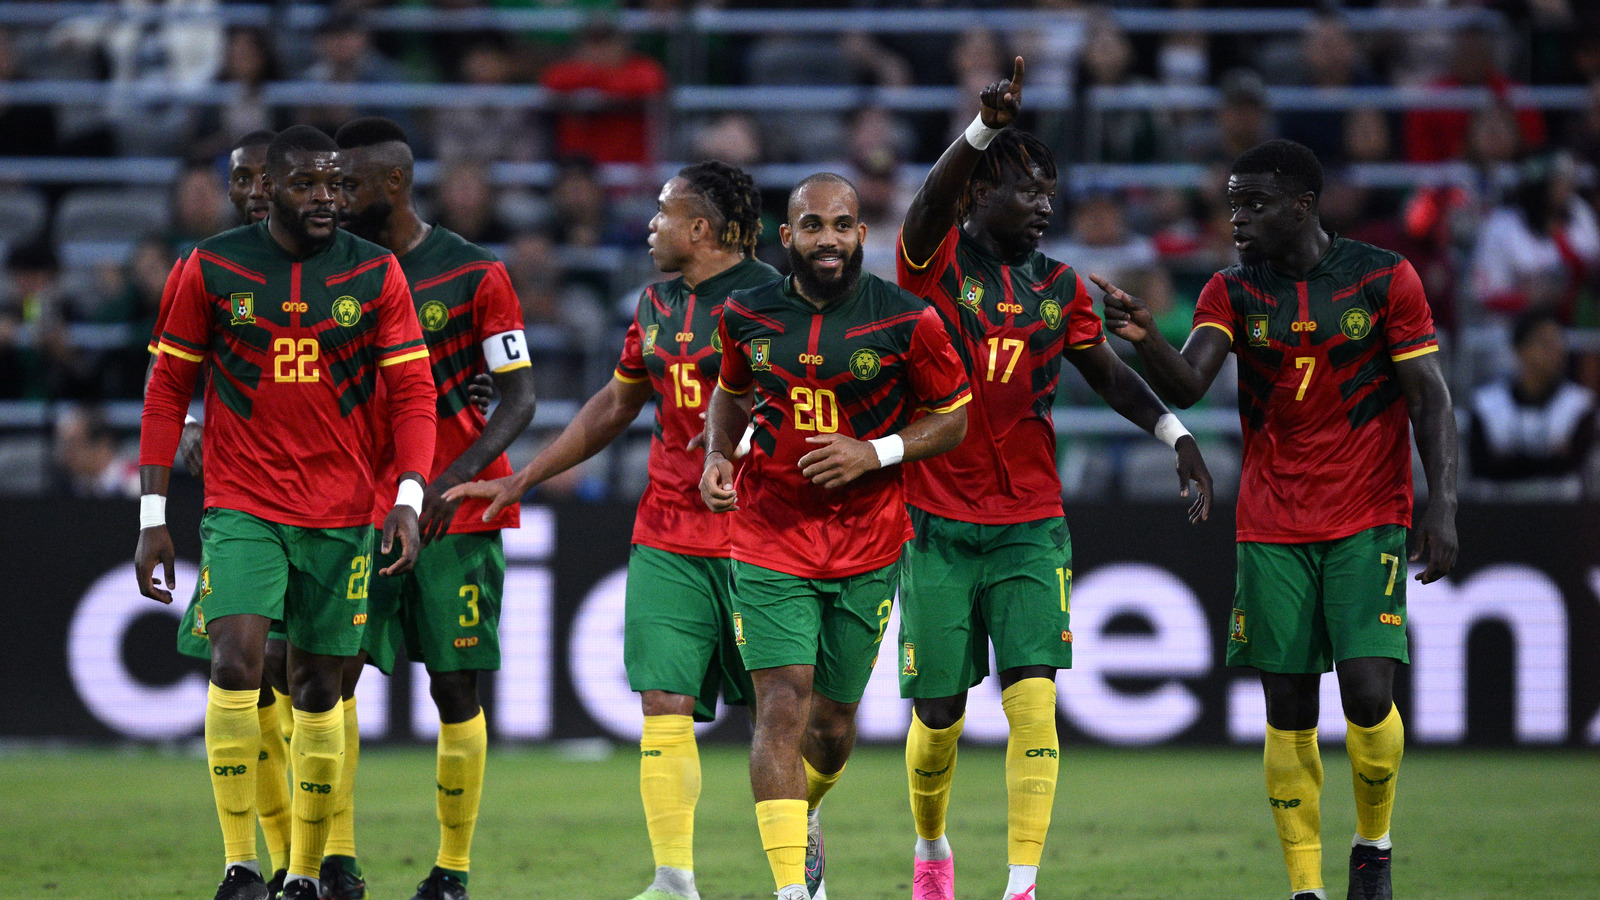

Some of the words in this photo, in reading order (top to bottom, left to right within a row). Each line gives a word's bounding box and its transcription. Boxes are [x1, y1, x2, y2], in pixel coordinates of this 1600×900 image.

[281, 302, 309, 313] one
[996, 302, 1025, 314] one
[1291, 321, 1318, 332] one
[675, 331, 694, 343] one
[502, 334, 520, 360] C
[274, 338, 320, 382] 22
[798, 353, 825, 366] one
[986, 337, 1025, 384] 17
[670, 363, 702, 408] 15
[1295, 357, 1316, 401] 7
[791, 387, 838, 433] 20
[1381, 553, 1399, 596] 7
[459, 584, 480, 627] 3
[1380, 613, 1402, 626] one
[454, 636, 479, 648] one
[1025, 748, 1058, 759] one
[213, 764, 247, 776] one
[300, 782, 332, 794] one
[1269, 797, 1301, 809] one
